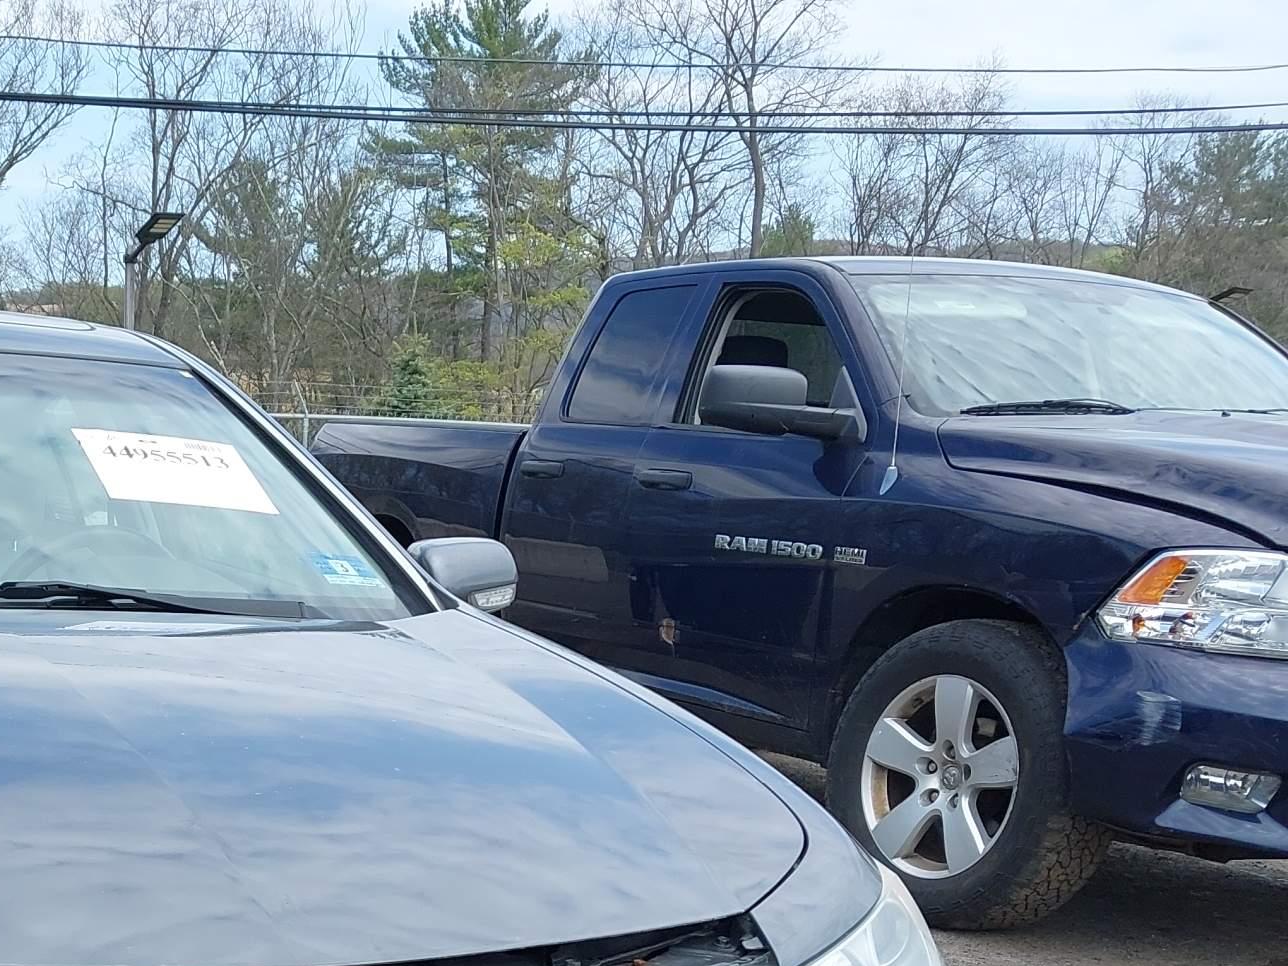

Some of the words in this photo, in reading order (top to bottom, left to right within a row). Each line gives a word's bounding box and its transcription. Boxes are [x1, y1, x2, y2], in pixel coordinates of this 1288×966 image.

[102, 445, 230, 470] 44955513
[715, 534, 768, 554] RAM
[771, 539, 824, 560] 1500
